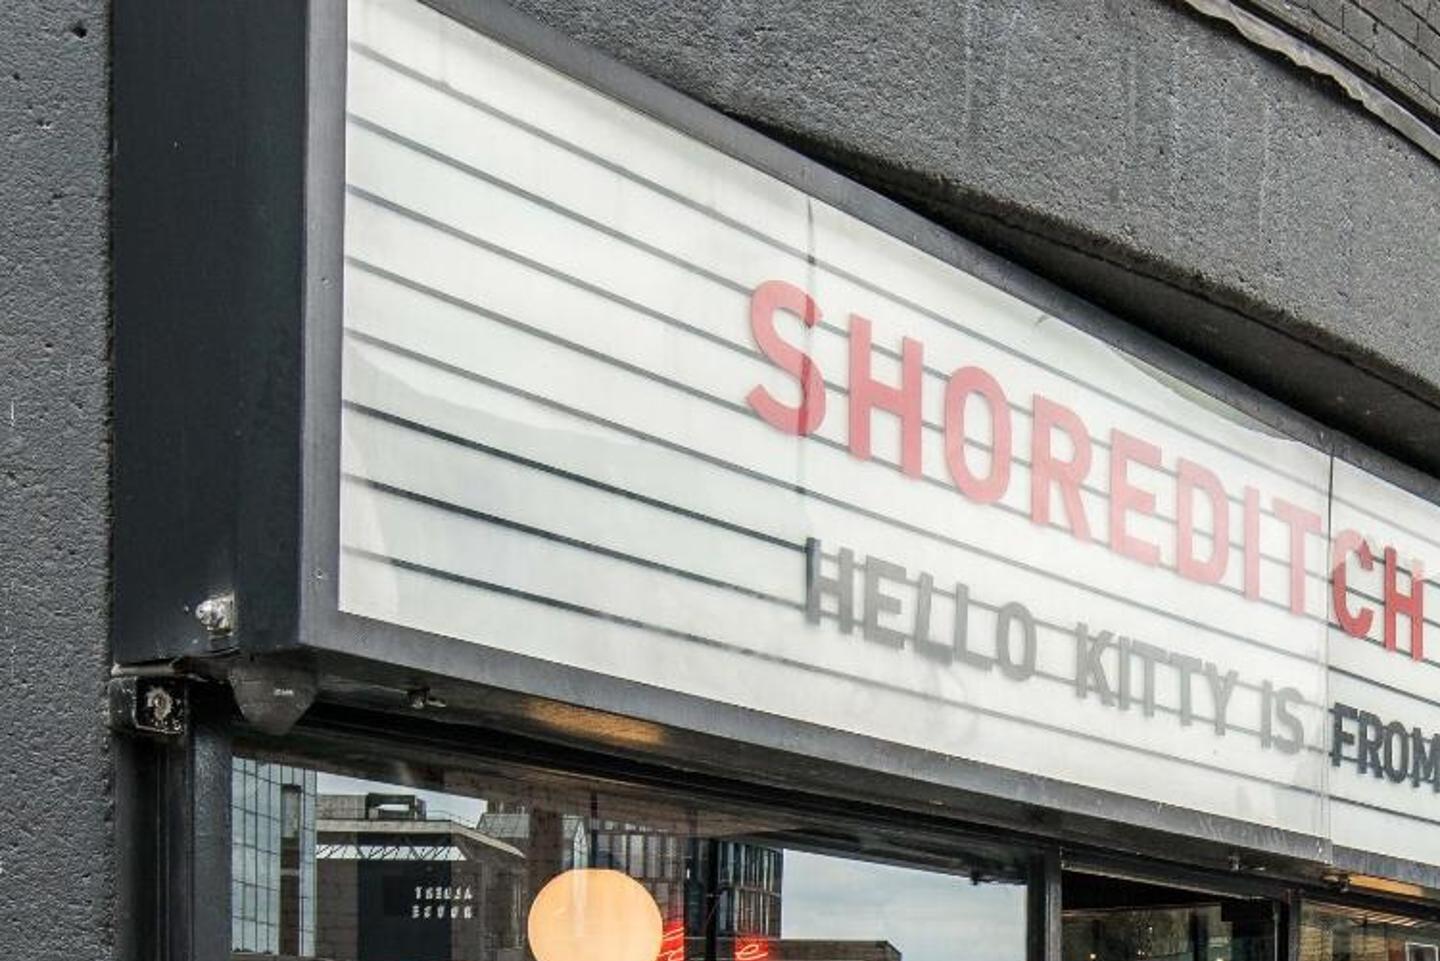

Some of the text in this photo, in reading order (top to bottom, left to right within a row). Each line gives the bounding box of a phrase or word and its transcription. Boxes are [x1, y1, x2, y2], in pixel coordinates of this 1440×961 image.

[746, 279, 1424, 663] SHOREDITCH
[805, 537, 1037, 682] HELLO
[1073, 622, 1238, 738] KITTY
[1260, 679, 1304, 755] IS
